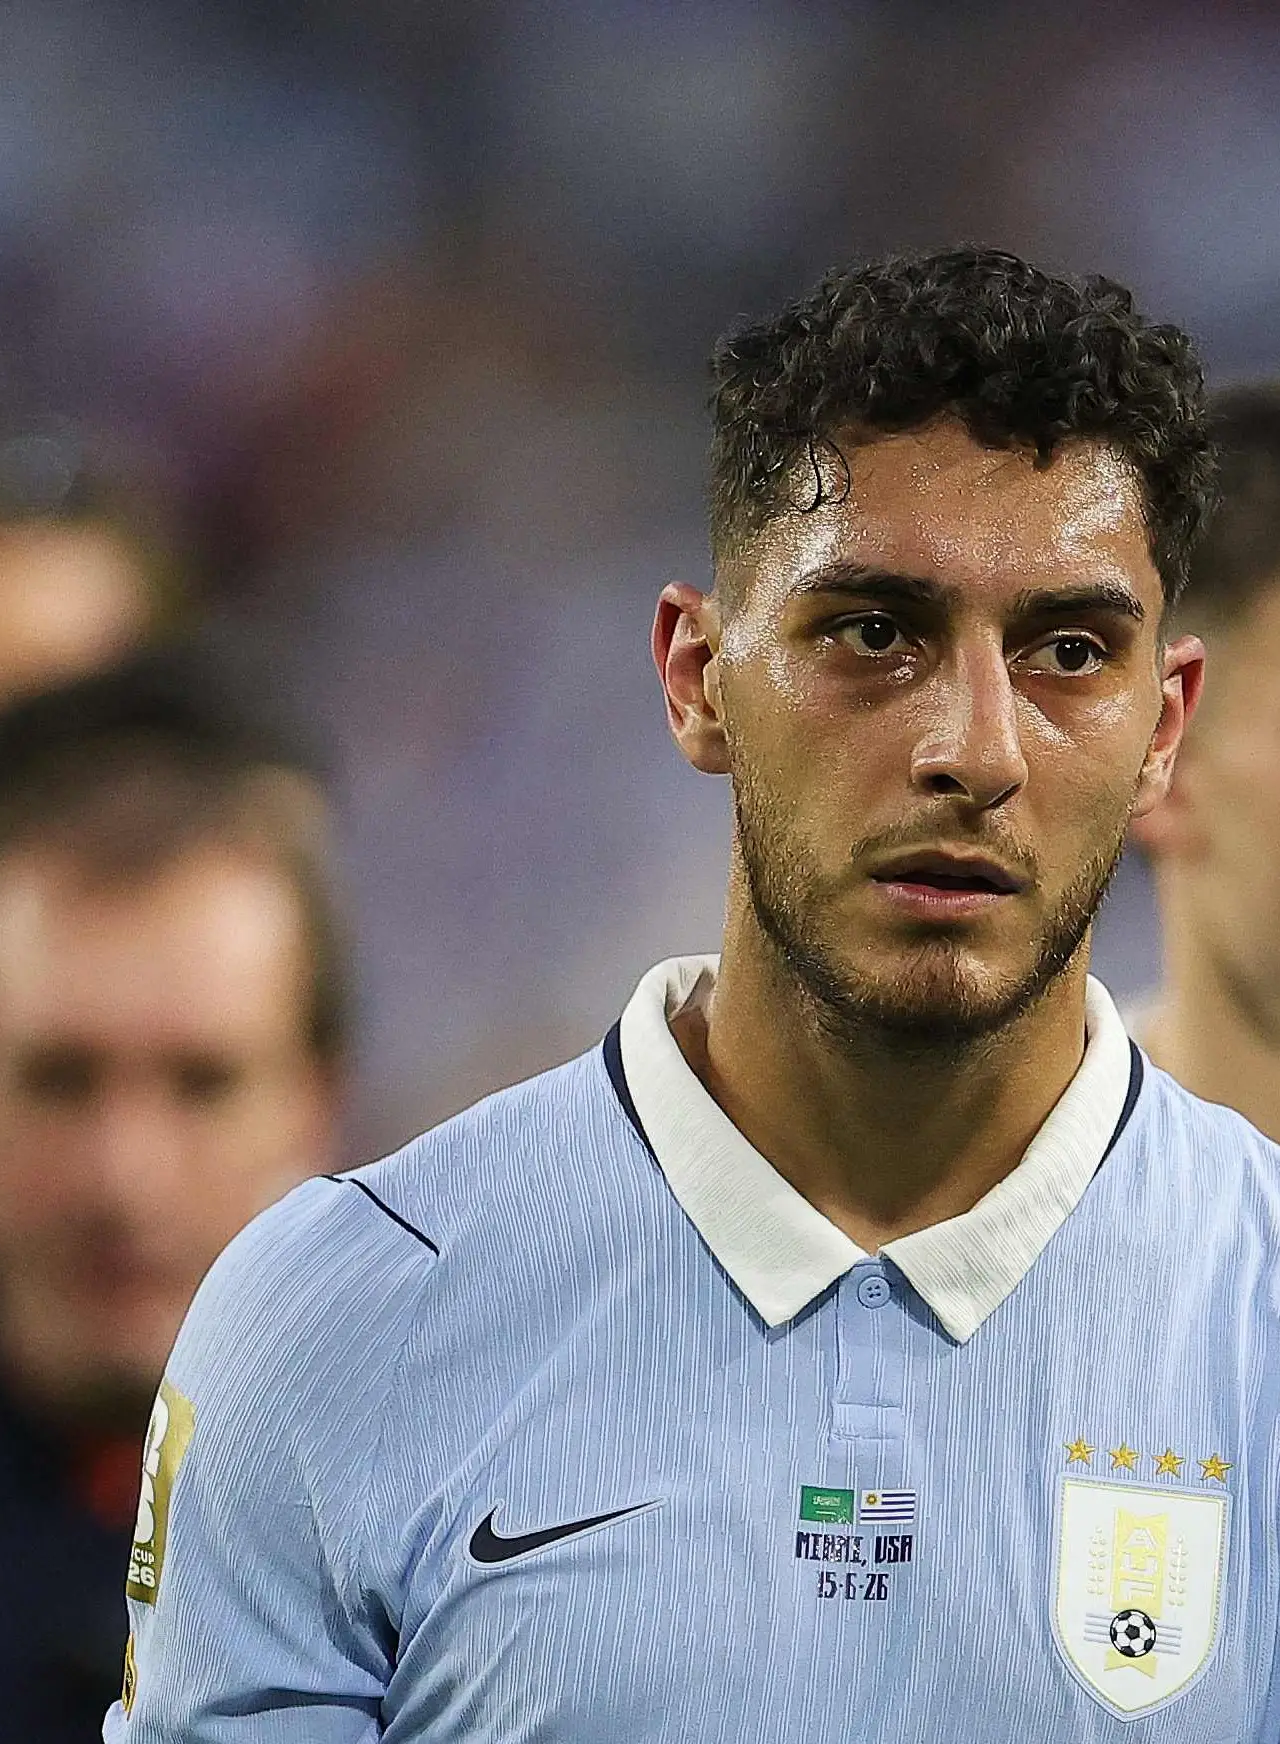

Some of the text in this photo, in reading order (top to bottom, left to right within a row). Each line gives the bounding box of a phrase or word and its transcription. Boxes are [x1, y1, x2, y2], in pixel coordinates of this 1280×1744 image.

[134, 1547, 156, 1565] CUP
[874, 1535, 913, 1564] USA
[127, 1560, 156, 1588] 26
